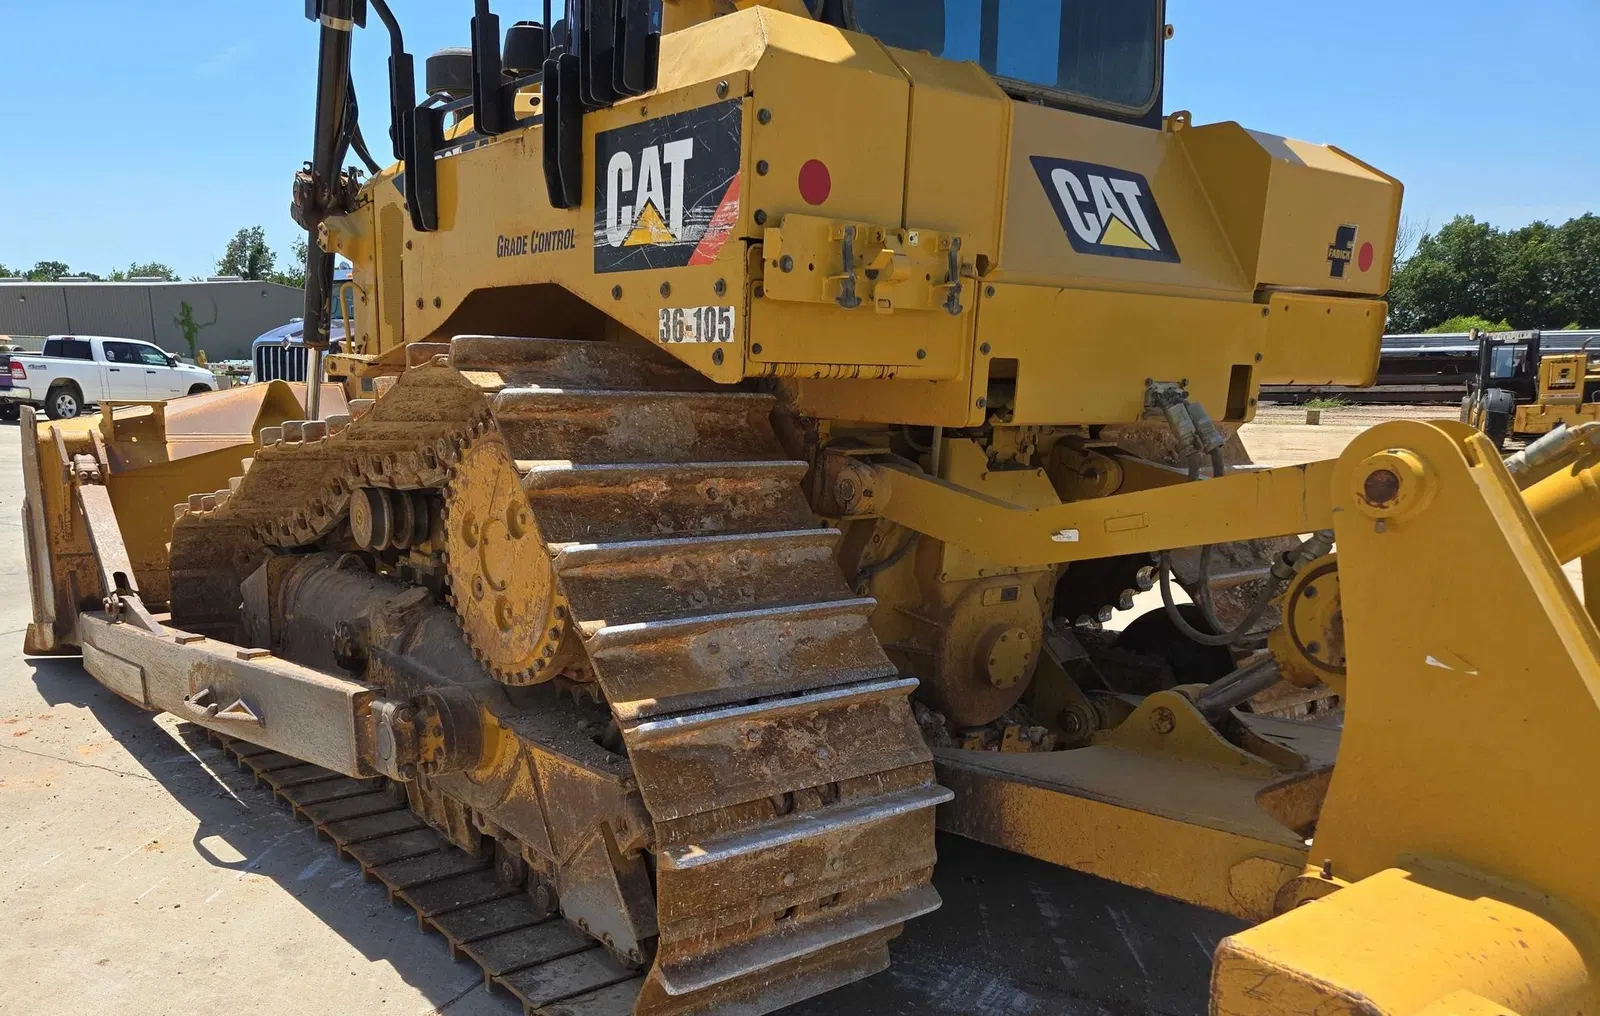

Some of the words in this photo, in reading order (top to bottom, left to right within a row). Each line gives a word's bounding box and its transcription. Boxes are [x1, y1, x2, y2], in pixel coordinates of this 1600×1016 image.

[607, 138, 693, 247] CAT
[1051, 168, 1160, 251] CAT
[497, 234, 528, 258] GRADE
[530, 228, 575, 254] CONTROL
[660, 306, 731, 343] 36-105
